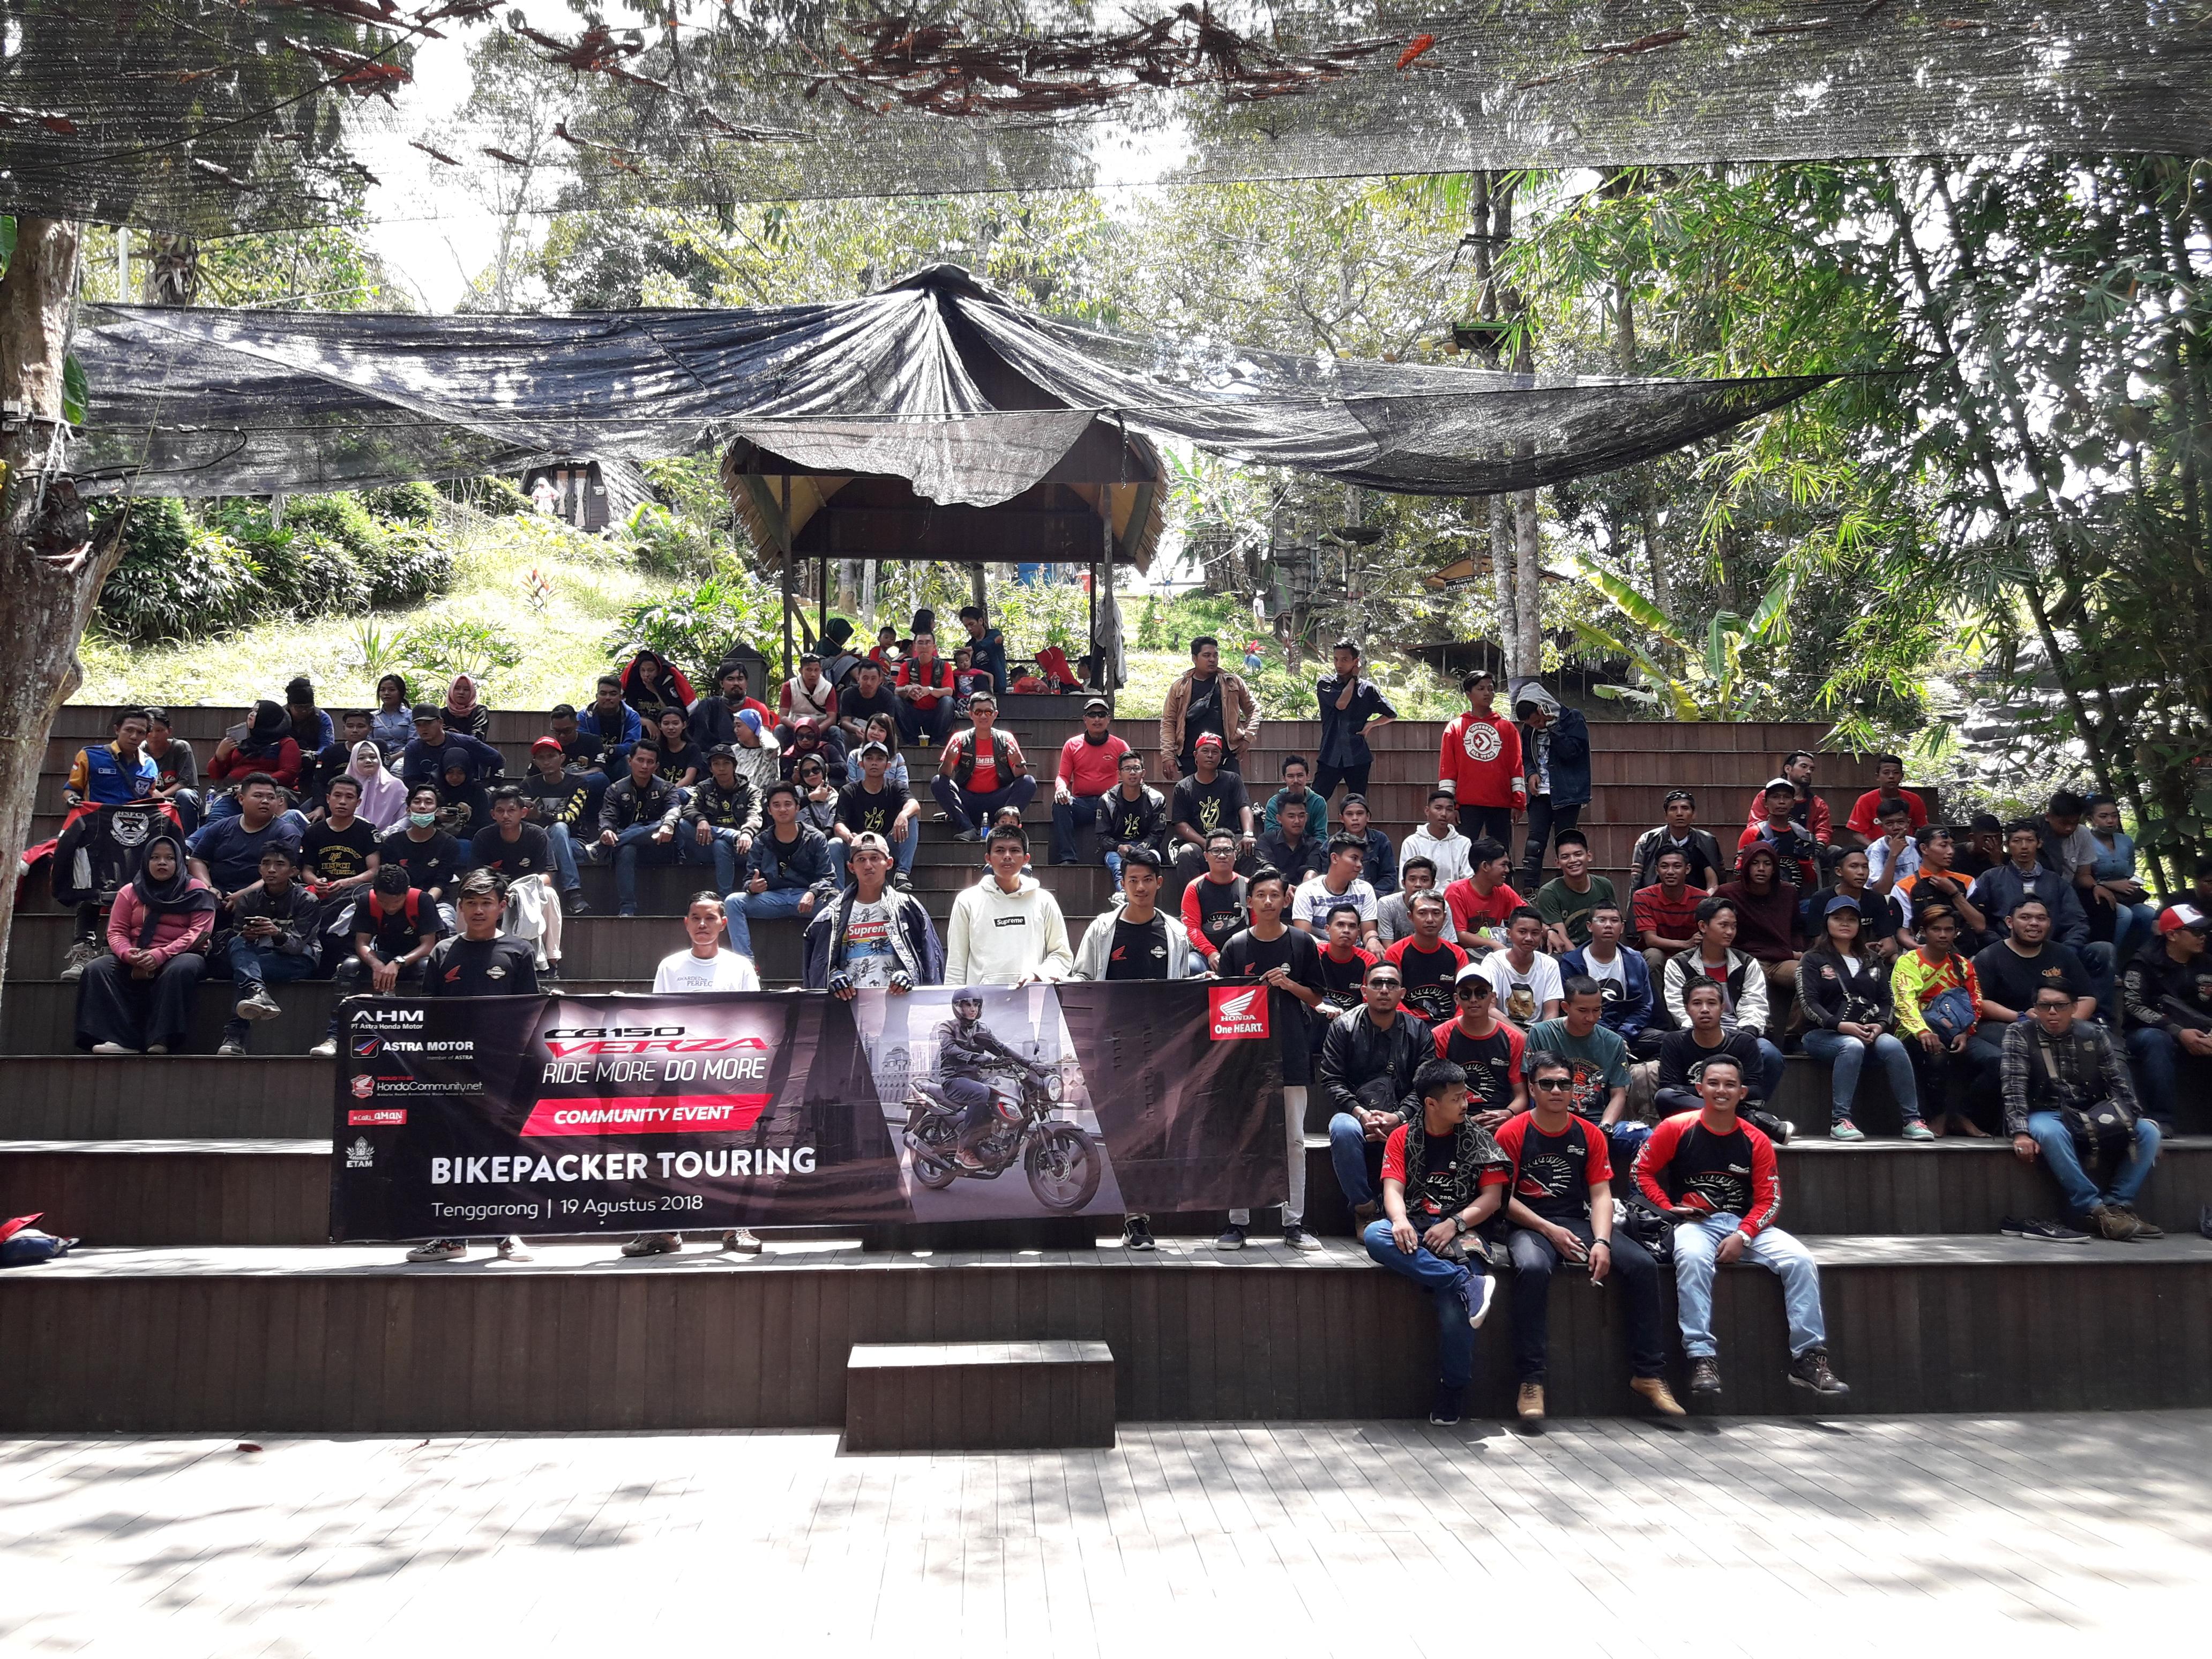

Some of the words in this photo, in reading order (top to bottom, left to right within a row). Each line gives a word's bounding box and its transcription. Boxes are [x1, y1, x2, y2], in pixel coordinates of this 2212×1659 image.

[848, 925, 887, 937] Suprem
[351, 1010, 424, 1022] AHM
[544, 1026, 685, 1038] CB150
[1214, 1024, 1233, 1034] One
[1234, 1023, 1264, 1033] HEART.
[382, 1042, 424, 1051] ASTRA
[427, 1041, 474, 1051] MOTOR
[544, 1037, 769, 1060] VERZA
[542, 1062, 592, 1084] RIDE
[595, 1060, 658, 1082] MORE
[664, 1058, 697, 1081] DO
[702, 1057, 767, 1080] MORE
[377, 1081, 483, 1092] HondaCommunity.net
[554, 1107, 671, 1125] COMMUNITY
[672, 1105, 735, 1120] EVENT
[431, 1153, 648, 1185] BIKEPACKER
[656, 1147, 816, 1178] TOURING
[431, 1202, 539, 1221] Tenggarong
[560, 1199, 579, 1214] 19
[582, 1197, 656, 1217] Agustus
[661, 1195, 703, 1210] 2018
